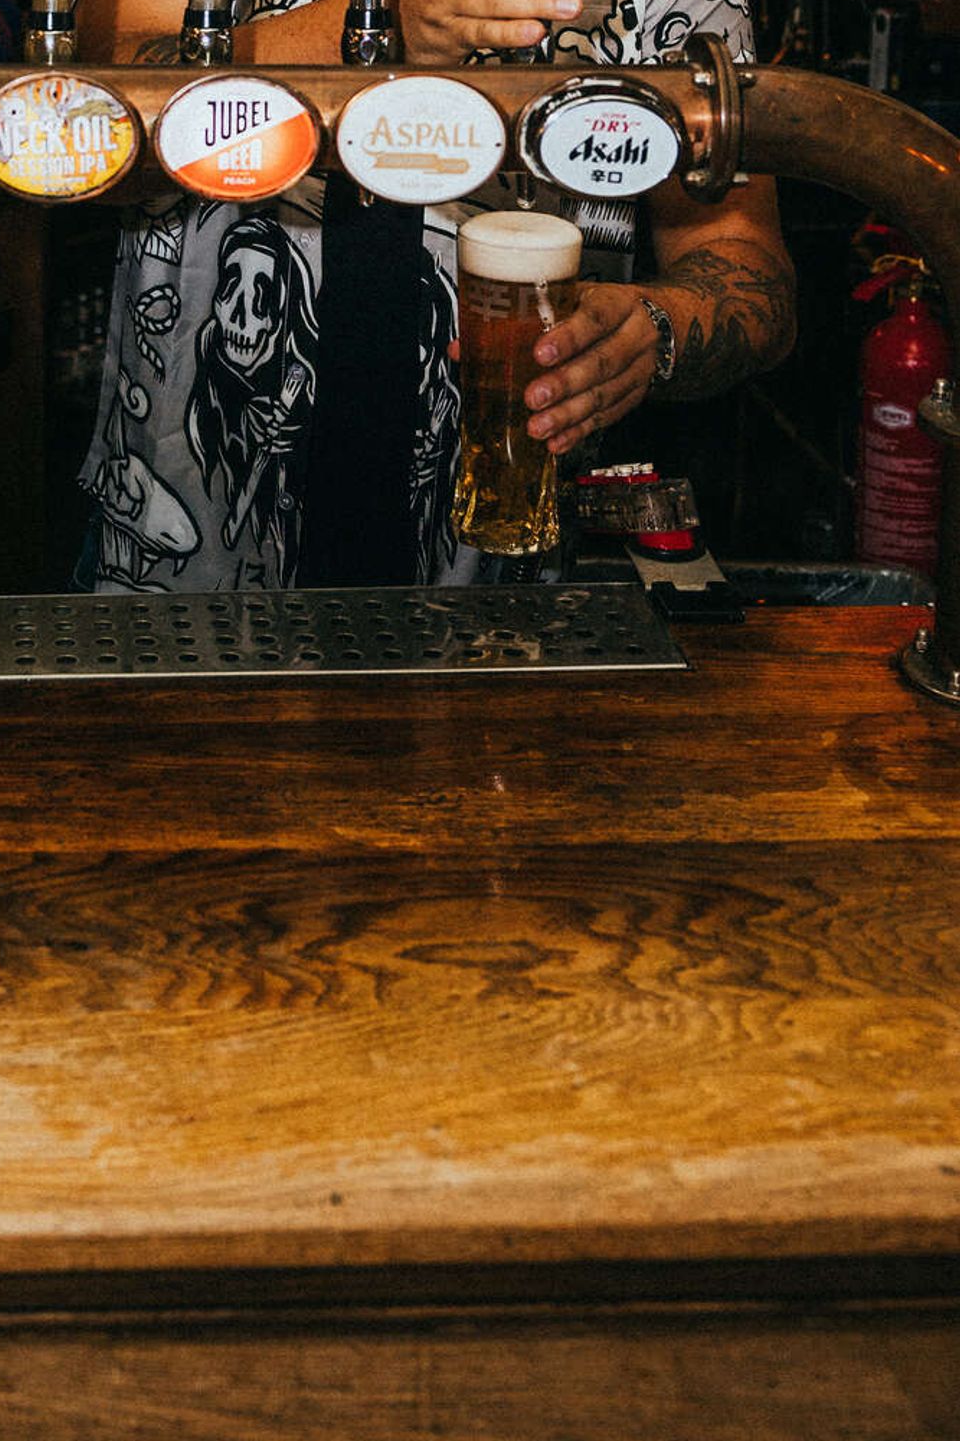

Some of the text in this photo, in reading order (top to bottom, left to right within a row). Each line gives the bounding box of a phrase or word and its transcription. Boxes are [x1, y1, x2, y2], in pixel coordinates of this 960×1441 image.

[72, 115, 118, 152] OIL
[205, 101, 271, 147] JUBEL
[369, 115, 481, 148] ASPALL
[79, 153, 107, 174] IPA
[569, 134, 650, 165] Asahi
[591, 169, 623, 184] 辛口
